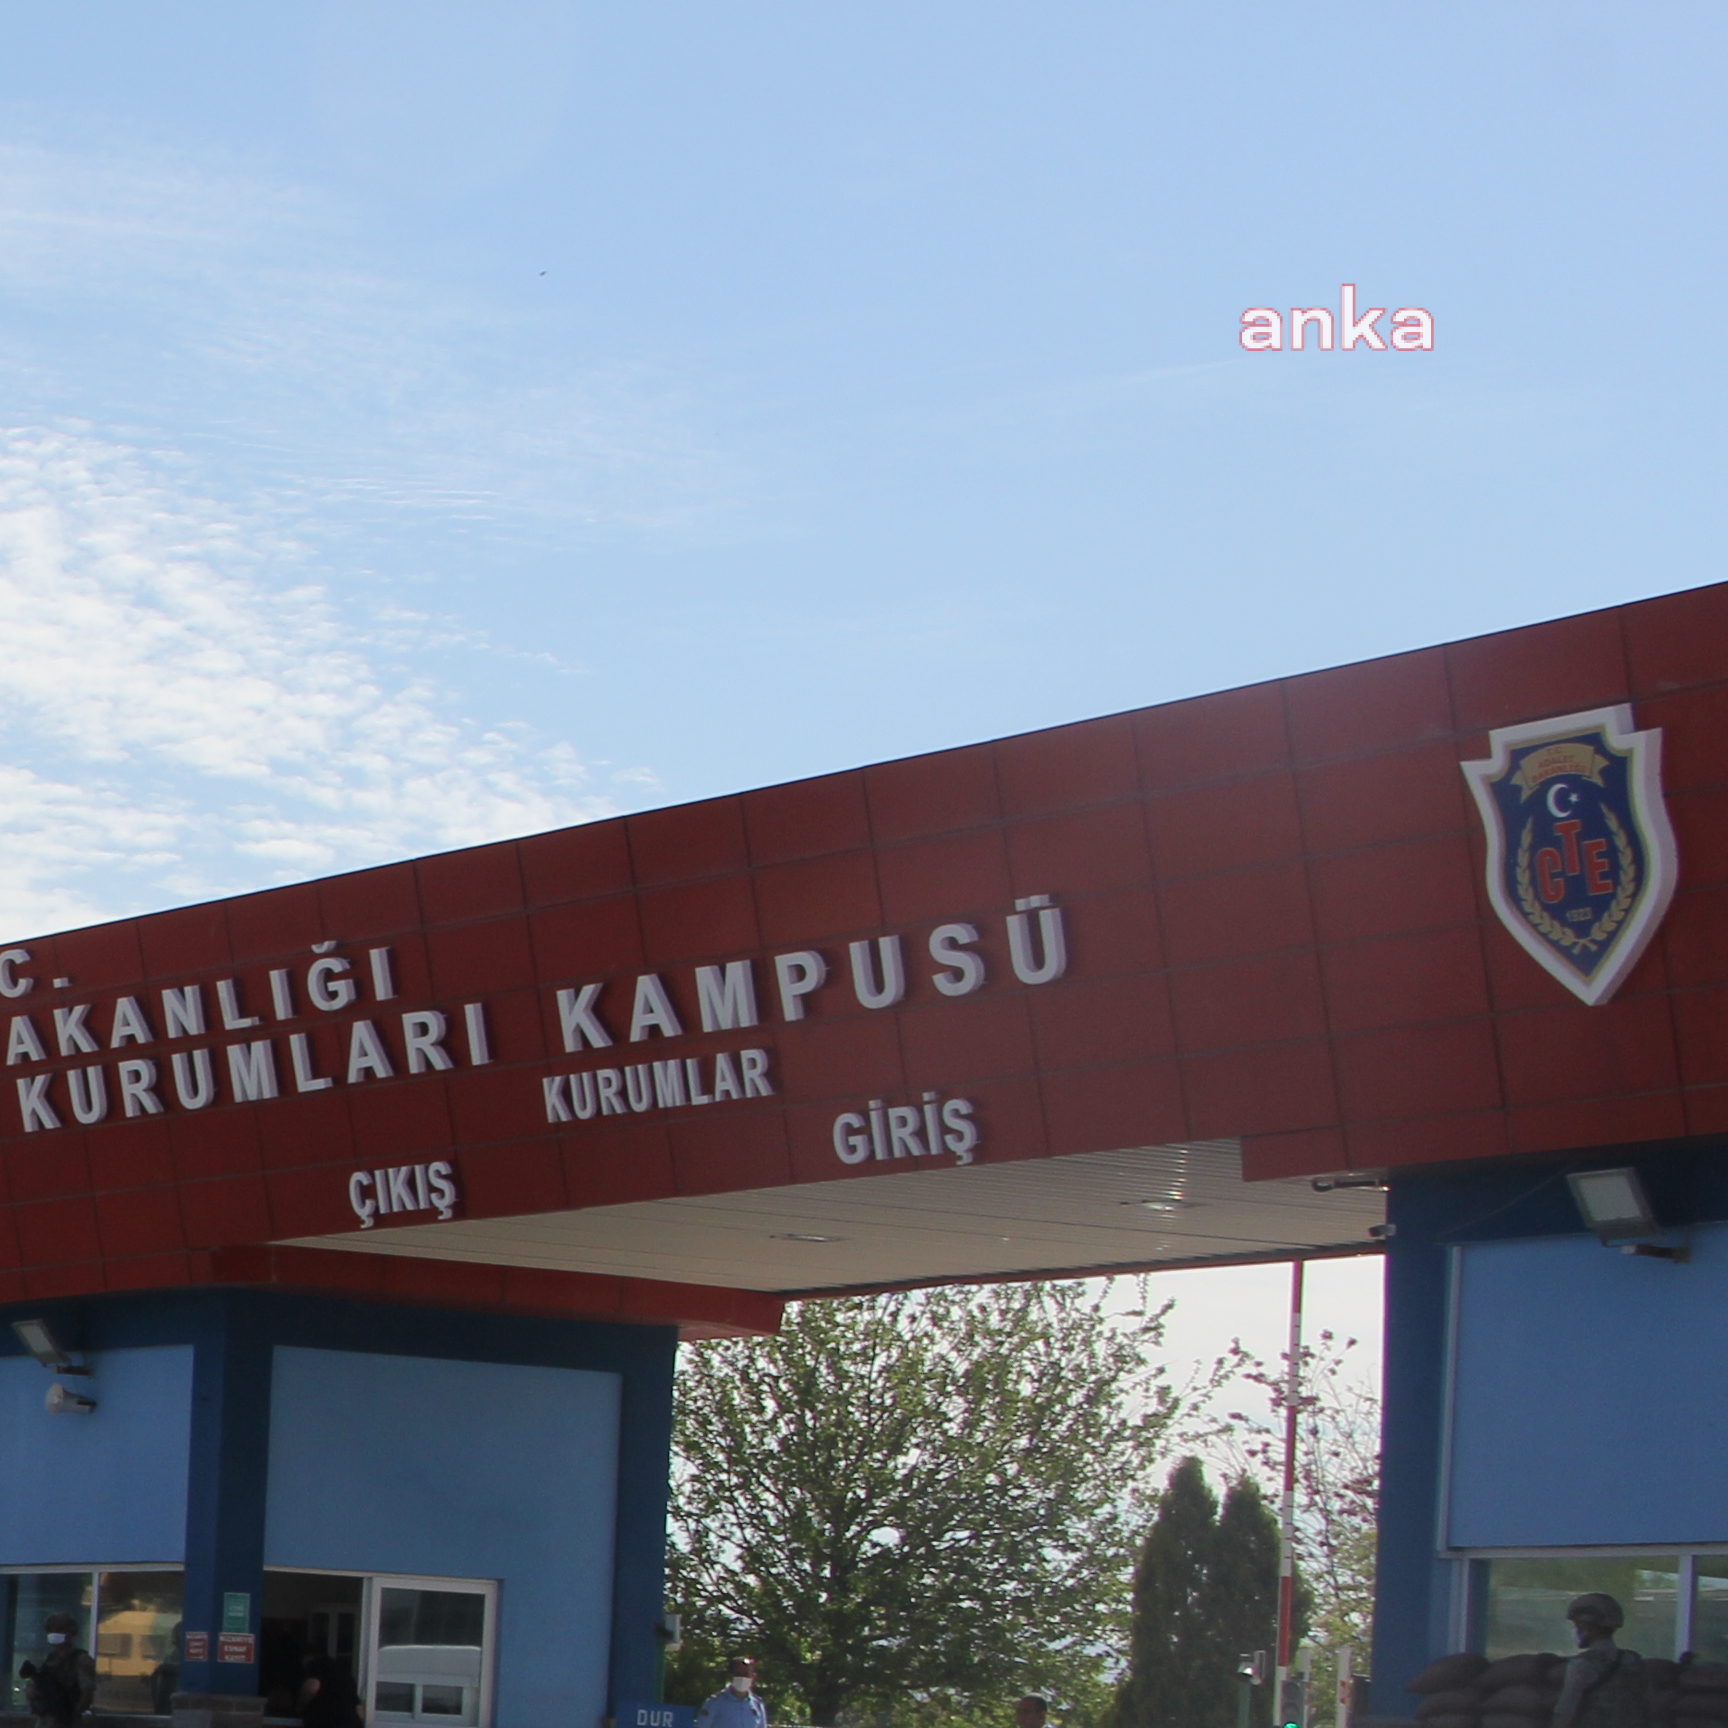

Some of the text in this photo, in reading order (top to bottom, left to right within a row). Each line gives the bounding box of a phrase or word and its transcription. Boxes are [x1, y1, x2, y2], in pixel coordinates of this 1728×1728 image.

[16, 1002, 496, 1133] KURUMLARI
[556, 894, 1070, 1053] KAMPUSÜ
[542, 1047, 776, 1123] KURUMLAR
[832, 1091, 980, 1166] GİRİŞ
[348, 1160, 460, 1229] ÇIKIŞ
[636, 1708, 674, 1728] DUR
